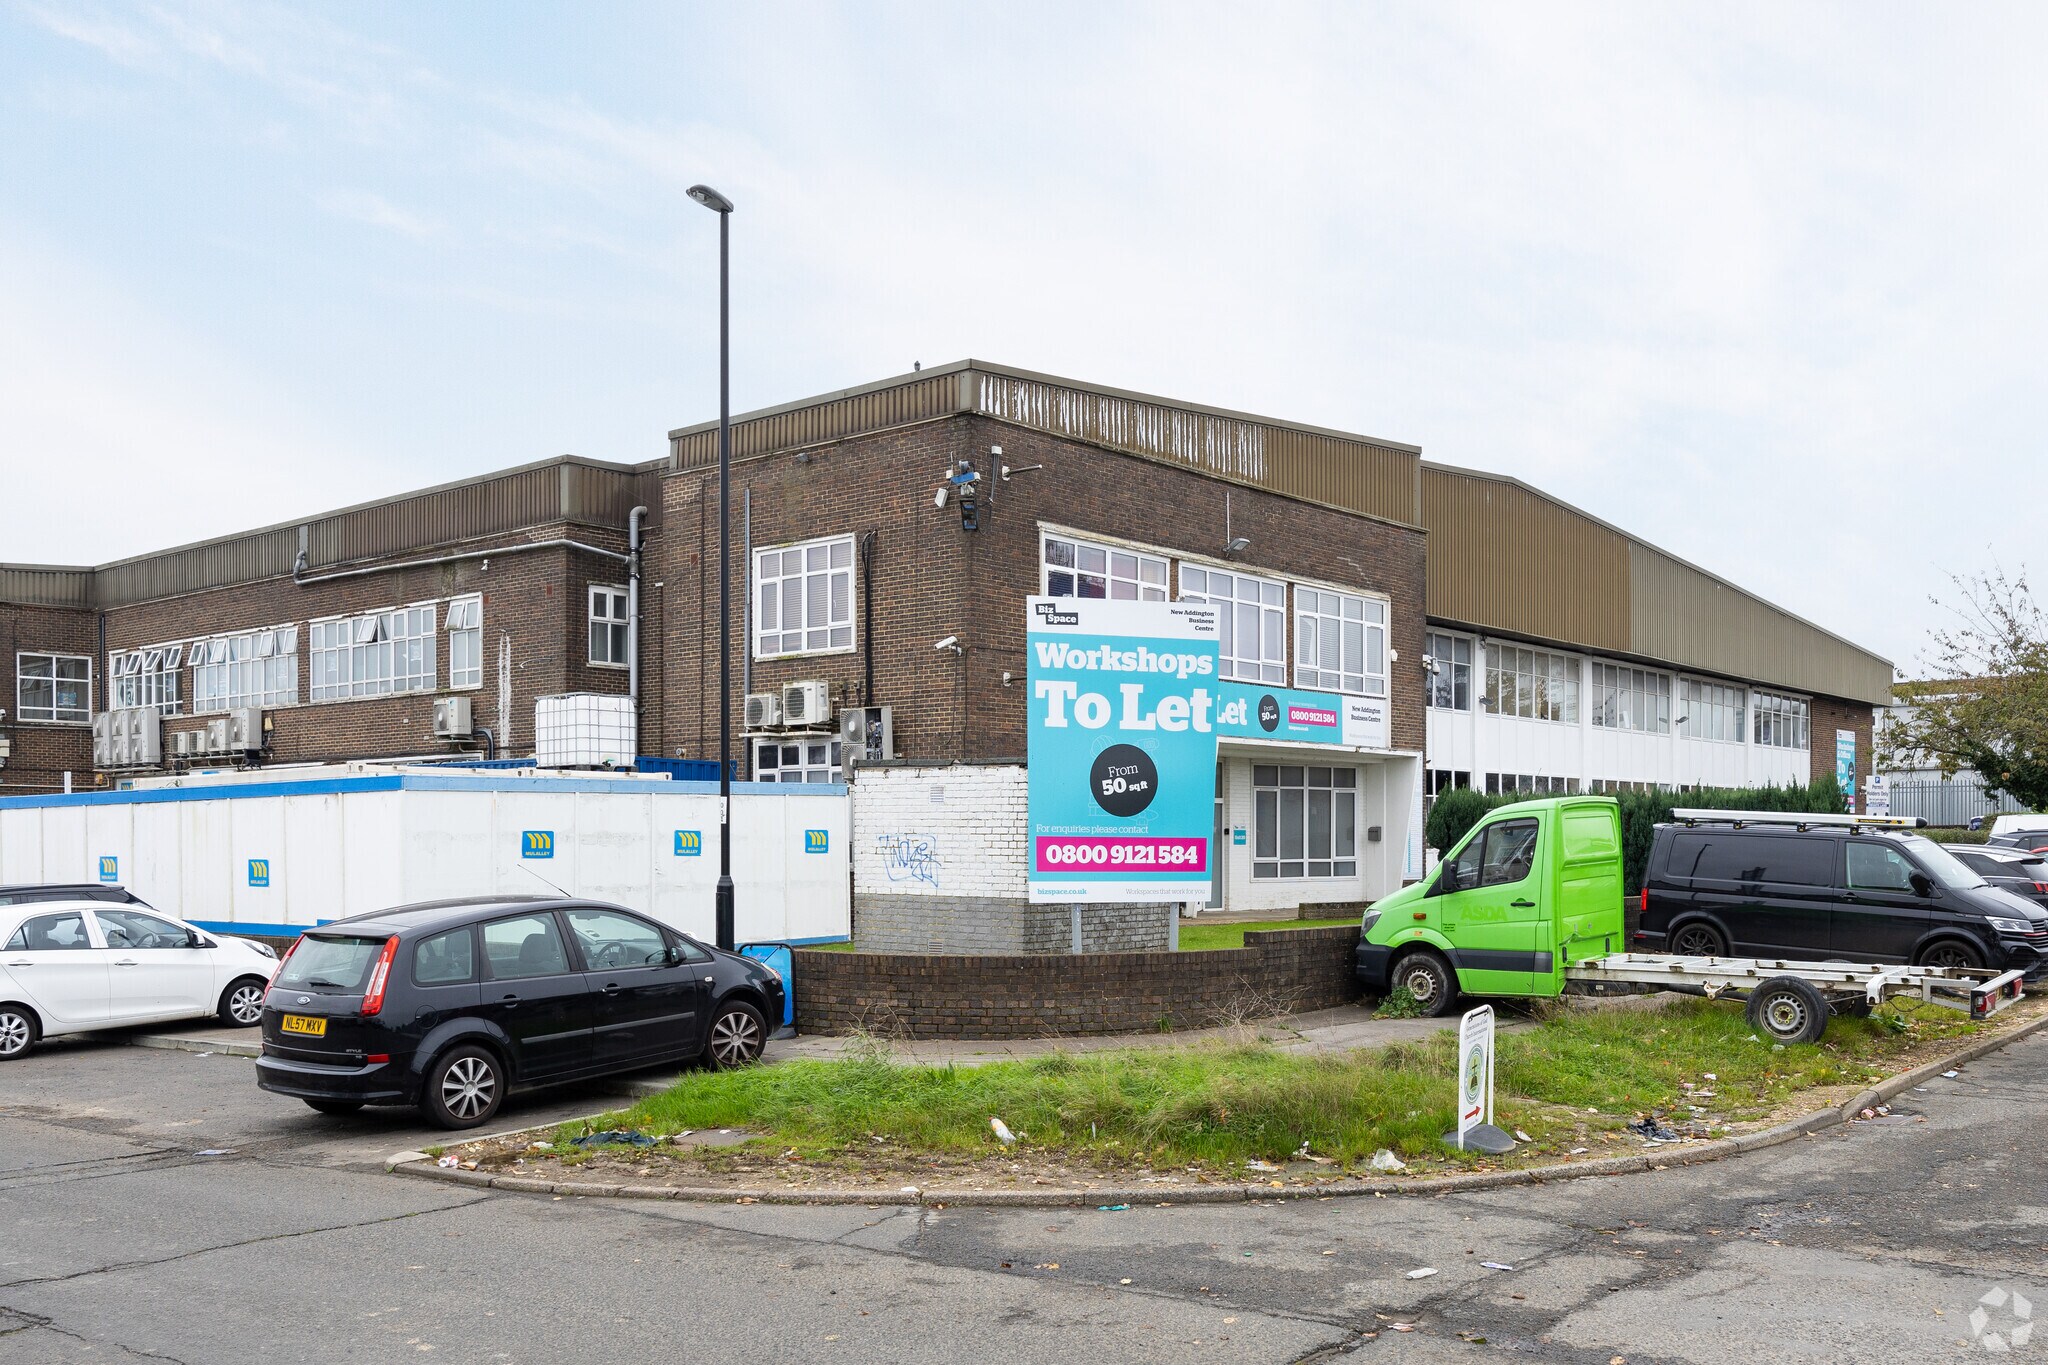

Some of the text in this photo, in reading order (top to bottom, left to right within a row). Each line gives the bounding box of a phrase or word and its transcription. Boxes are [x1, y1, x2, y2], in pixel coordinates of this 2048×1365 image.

[1038, 605, 1054, 614] Biz
[1184, 609, 1215, 618] Addington
[1047, 614, 1077, 624] Space
[1188, 617, 1215, 625] Business
[1034, 642, 1213, 680] Workshops
[1035, 680, 1213, 733] To Let
[1360, 706, 1381, 715] Addington
[1261, 711, 1270, 721] 50
[1291, 710, 1335, 724] 0800 9121 584
[1350, 714, 1381, 723] Business Centre
[1108, 764, 1139, 777] From
[1102, 777, 1127, 796] 50
[1036, 824, 1149, 835] For enquiries please contact
[1046, 844, 1198, 865] 0800 9121 584
[1037, 888, 1087, 896] bizspace.co.uk
[1125, 888, 1159, 896] Workspaces
[1460, 904, 1508, 921] ASDA
[285, 1016, 322, 1033] NL57 MXV
